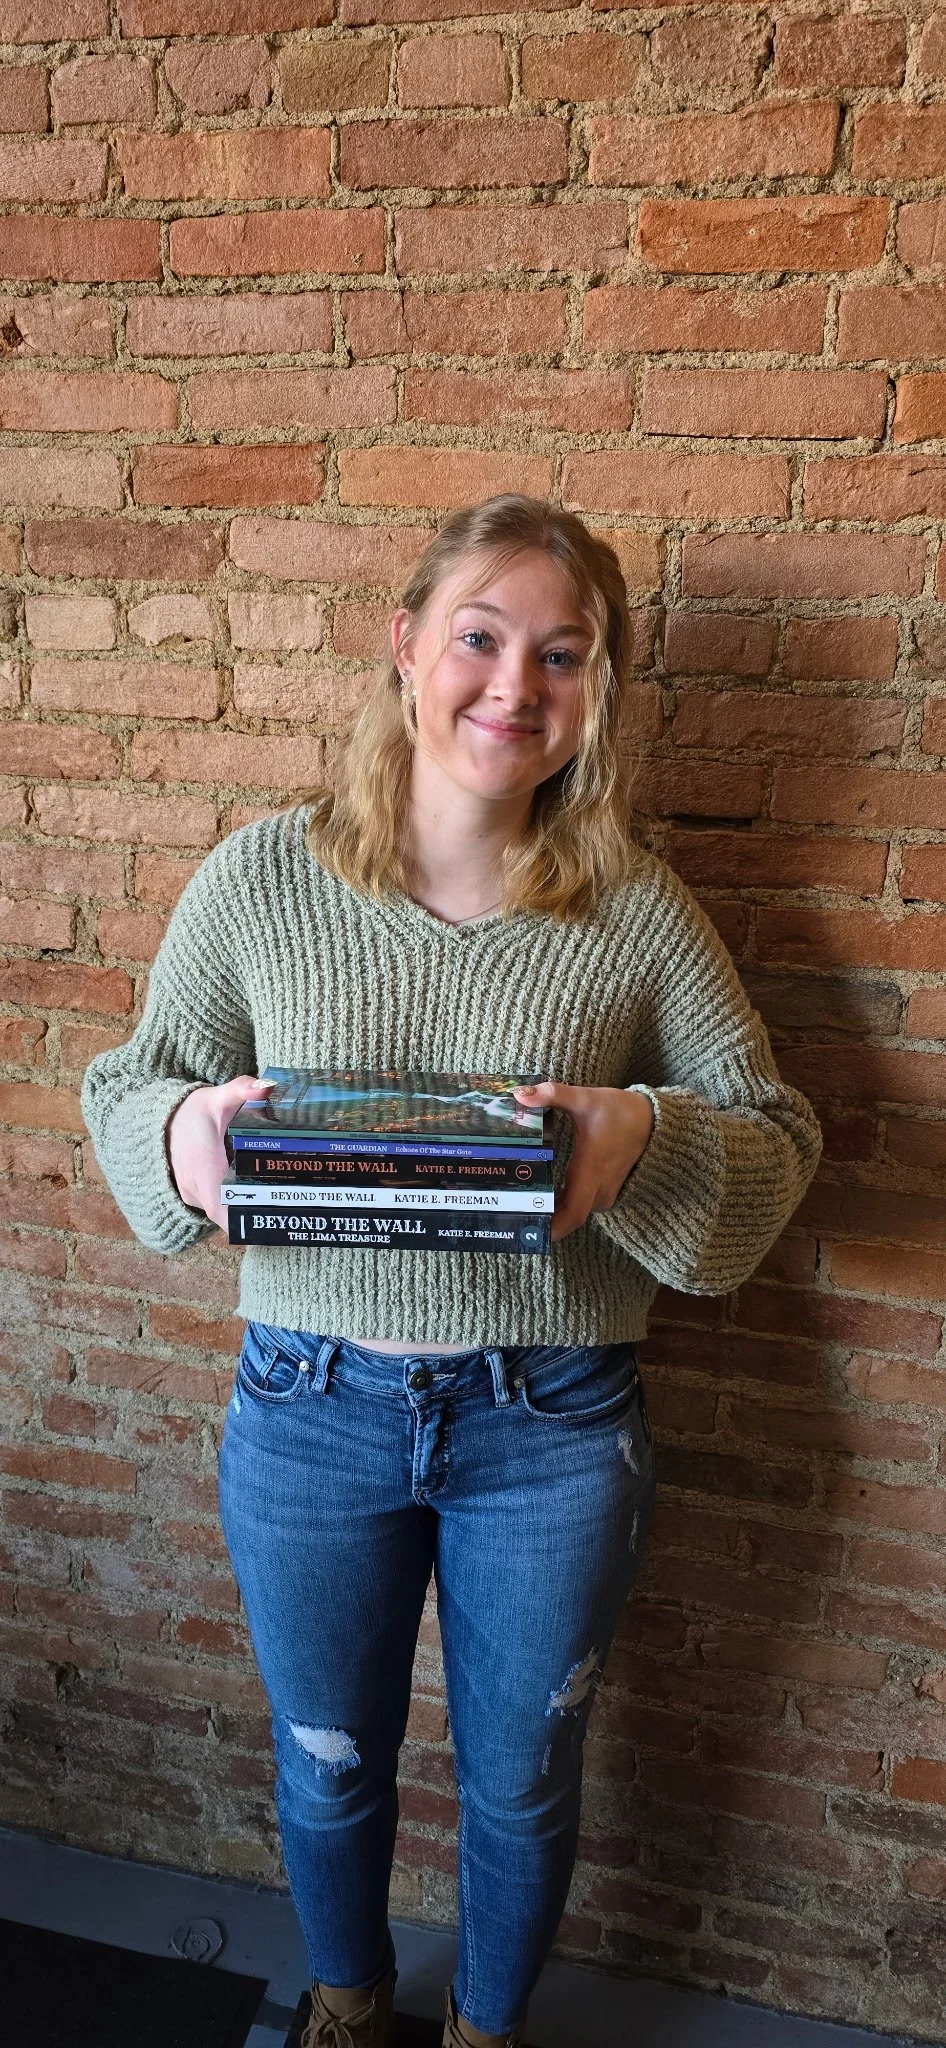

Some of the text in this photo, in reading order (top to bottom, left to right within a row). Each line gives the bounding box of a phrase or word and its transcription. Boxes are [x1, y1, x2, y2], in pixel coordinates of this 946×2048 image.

[244, 1141, 280, 1149] FREEMAN
[330, 1143, 388, 1152] THE GUARDIAN
[395, 1146, 419, 1154] Echoes
[266, 1159, 397, 1173] BEYOND THE WALL
[415, 1164, 506, 1175] KATIE E. FREEMAN
[270, 1191, 376, 1202] BEYOND THE WALL
[394, 1194, 499, 1205] KATIE E. FREEMAN
[252, 1215, 426, 1234] BEYOND THE WALL
[288, 1231, 391, 1243] THE LIMA TREASURE
[438, 1229, 515, 1239] KATIE E. FREEMAN
[525, 1232, 537, 1241] 2
